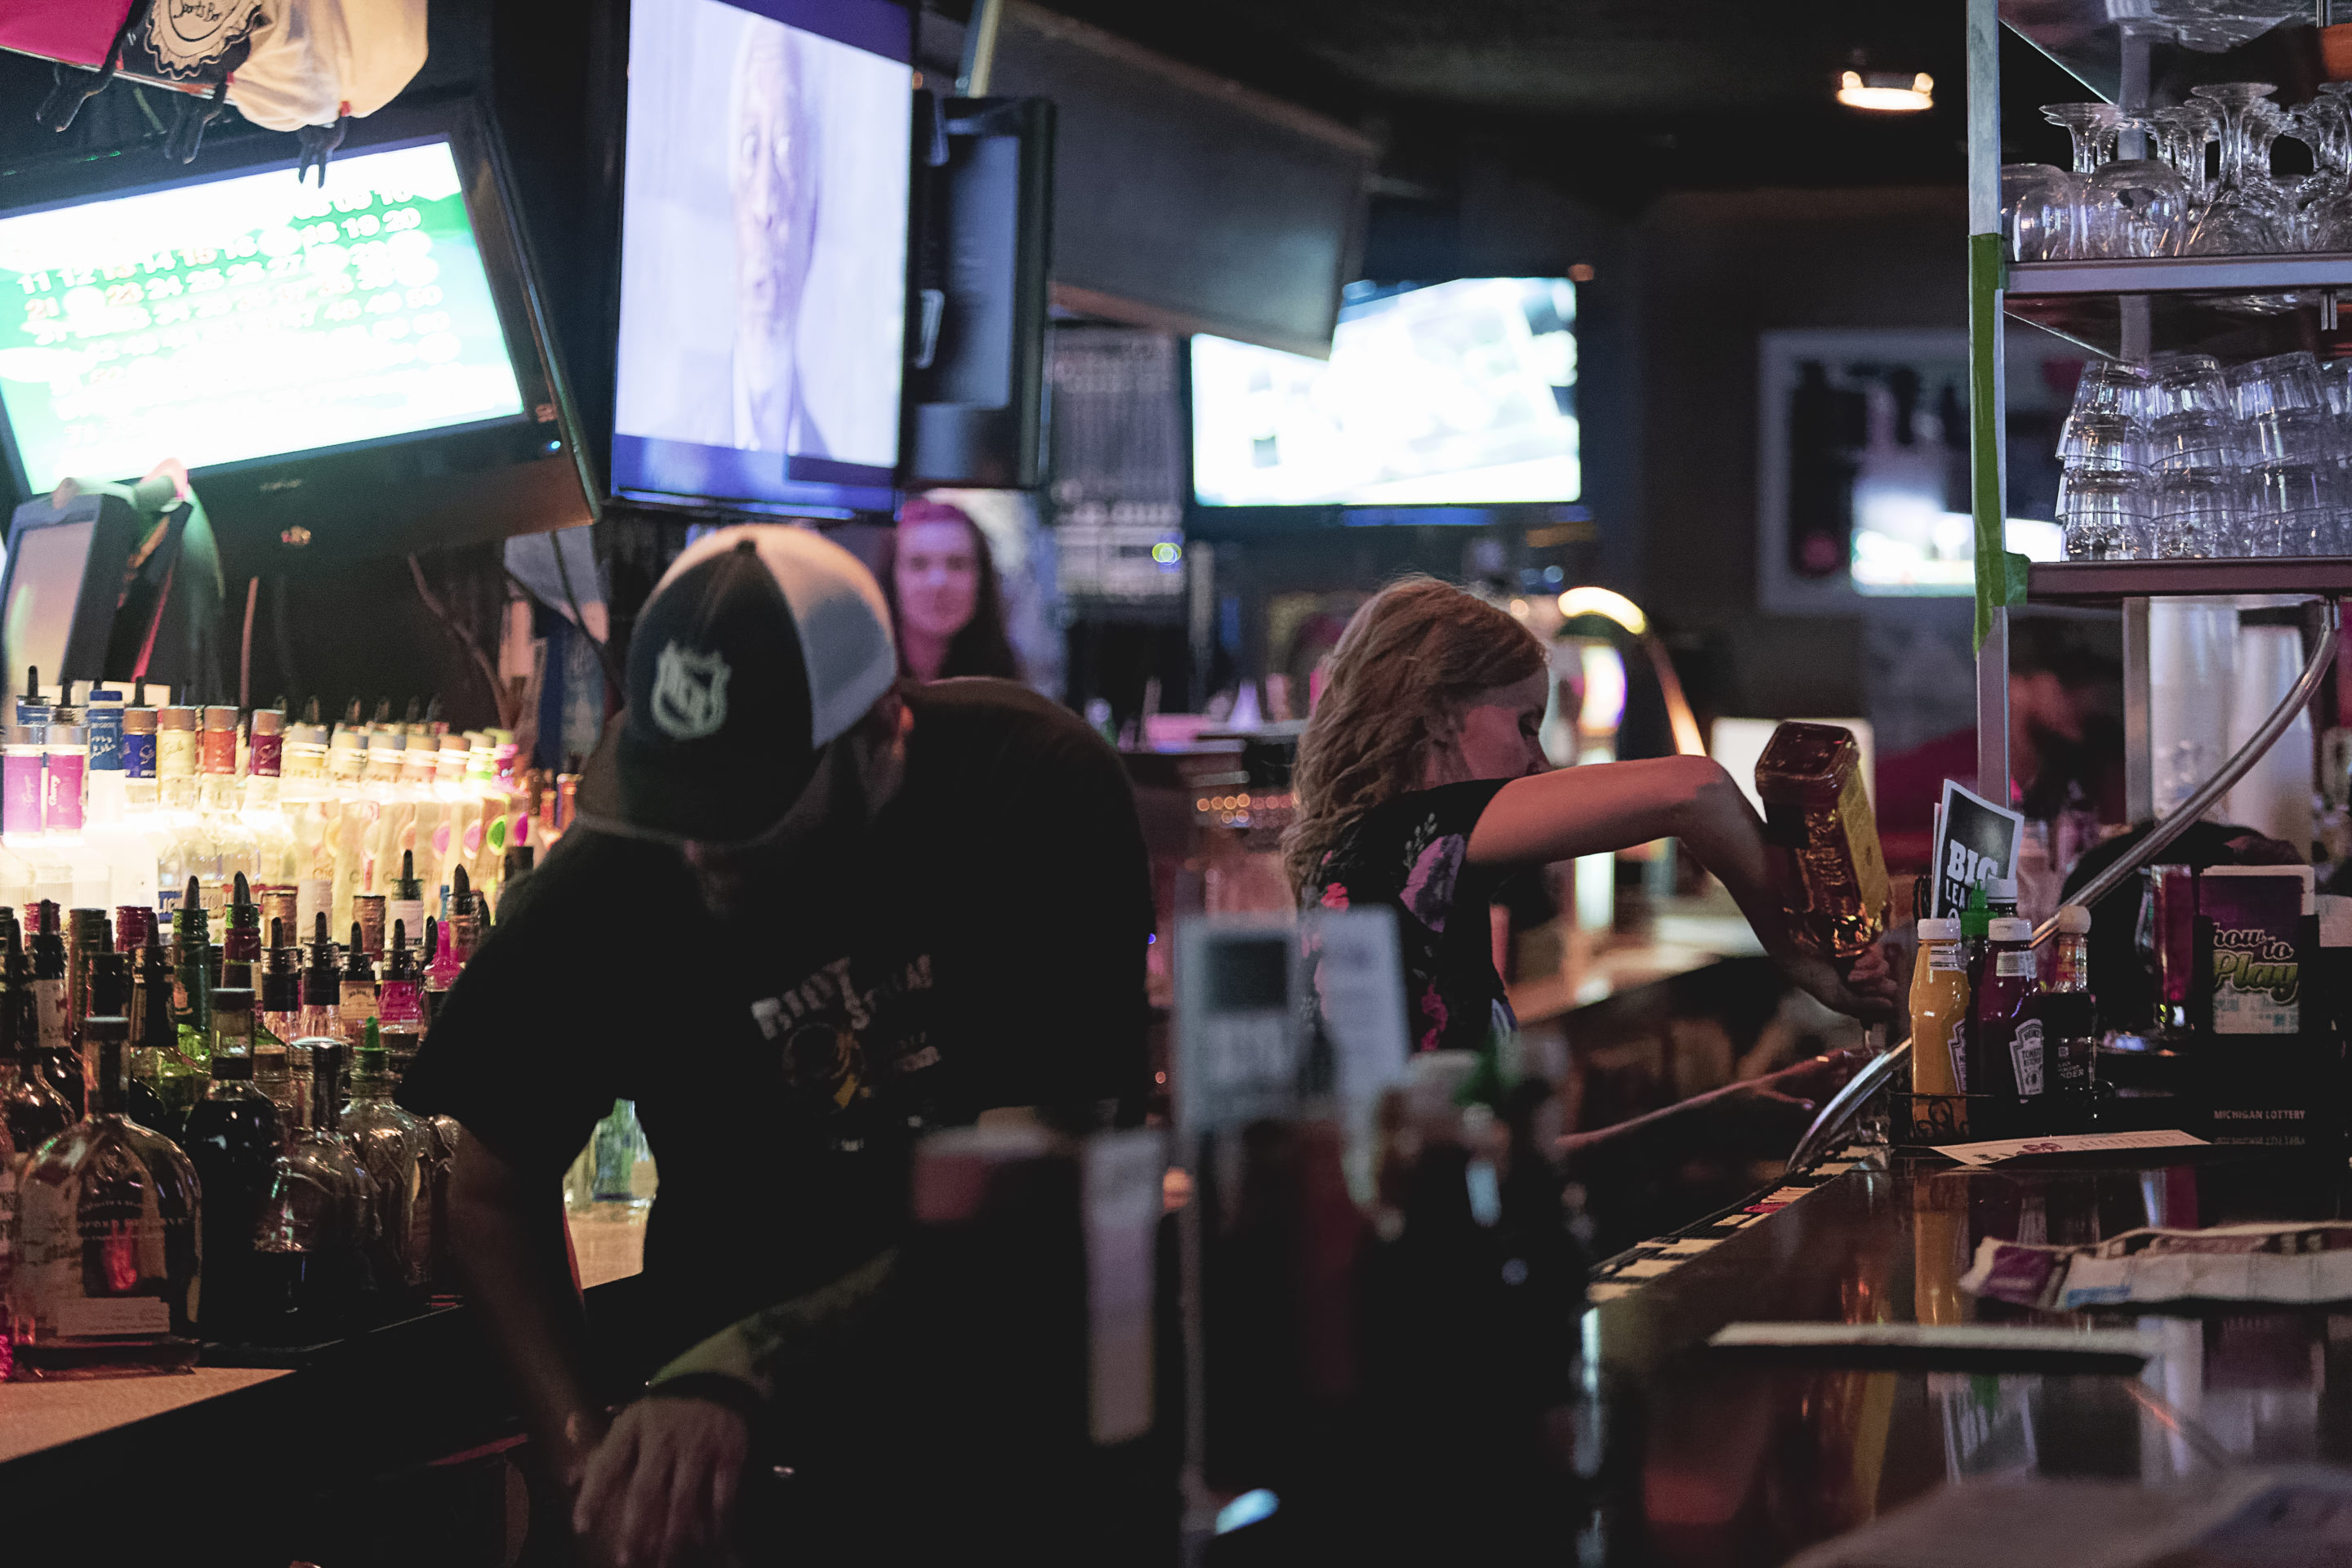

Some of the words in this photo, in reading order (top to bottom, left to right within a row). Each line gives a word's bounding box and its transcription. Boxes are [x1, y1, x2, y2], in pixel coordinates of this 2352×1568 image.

[16, 272, 52, 295] 11
[382, 207, 421, 232] 20
[2213, 949, 2299, 1004] Play
[2213, 1110, 2263, 1120] MICHIGAN
[2265, 1110, 2305, 1120] LOTTERY
